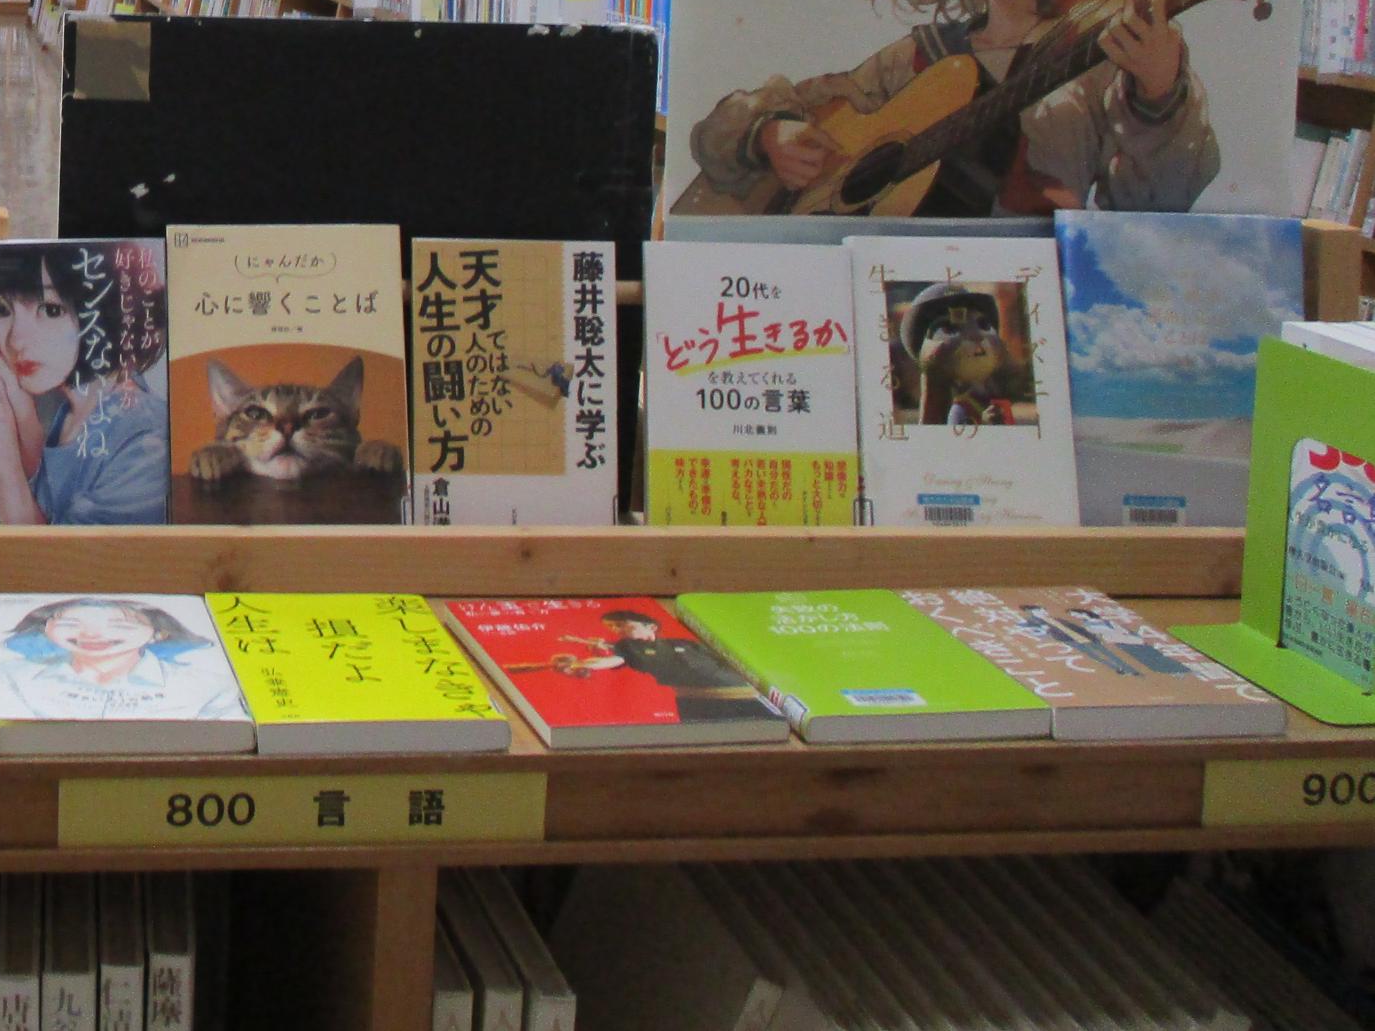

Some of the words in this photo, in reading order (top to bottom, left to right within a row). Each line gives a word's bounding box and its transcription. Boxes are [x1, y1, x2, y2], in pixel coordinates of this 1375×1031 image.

[138, 248, 160, 349] 私のことが
[195, 291, 379, 316] 心に響くことば
[459, 249, 503, 330] 天才
[720, 276, 782, 300] 20代を
[72, 247, 114, 459] センスないよね
[417, 251, 469, 474] 人生の闘い方
[466, 332, 493, 437] 人のための
[487, 329, 513, 416] ではない
[573, 252, 606, 470] 藤井聡太に学ぶ
[707, 371, 797, 386] を教えてくれる
[695, 388, 811, 414] 100の言葉
[217, 596, 291, 654] 人生は
[307, 618, 382, 681] 損だよ
[376, 597, 492, 717] 楽しまなきゃ
[902, 589, 1075, 698] おくべきこと
[166, 794, 256, 827] 800
[313, 789, 445, 828] 言語
